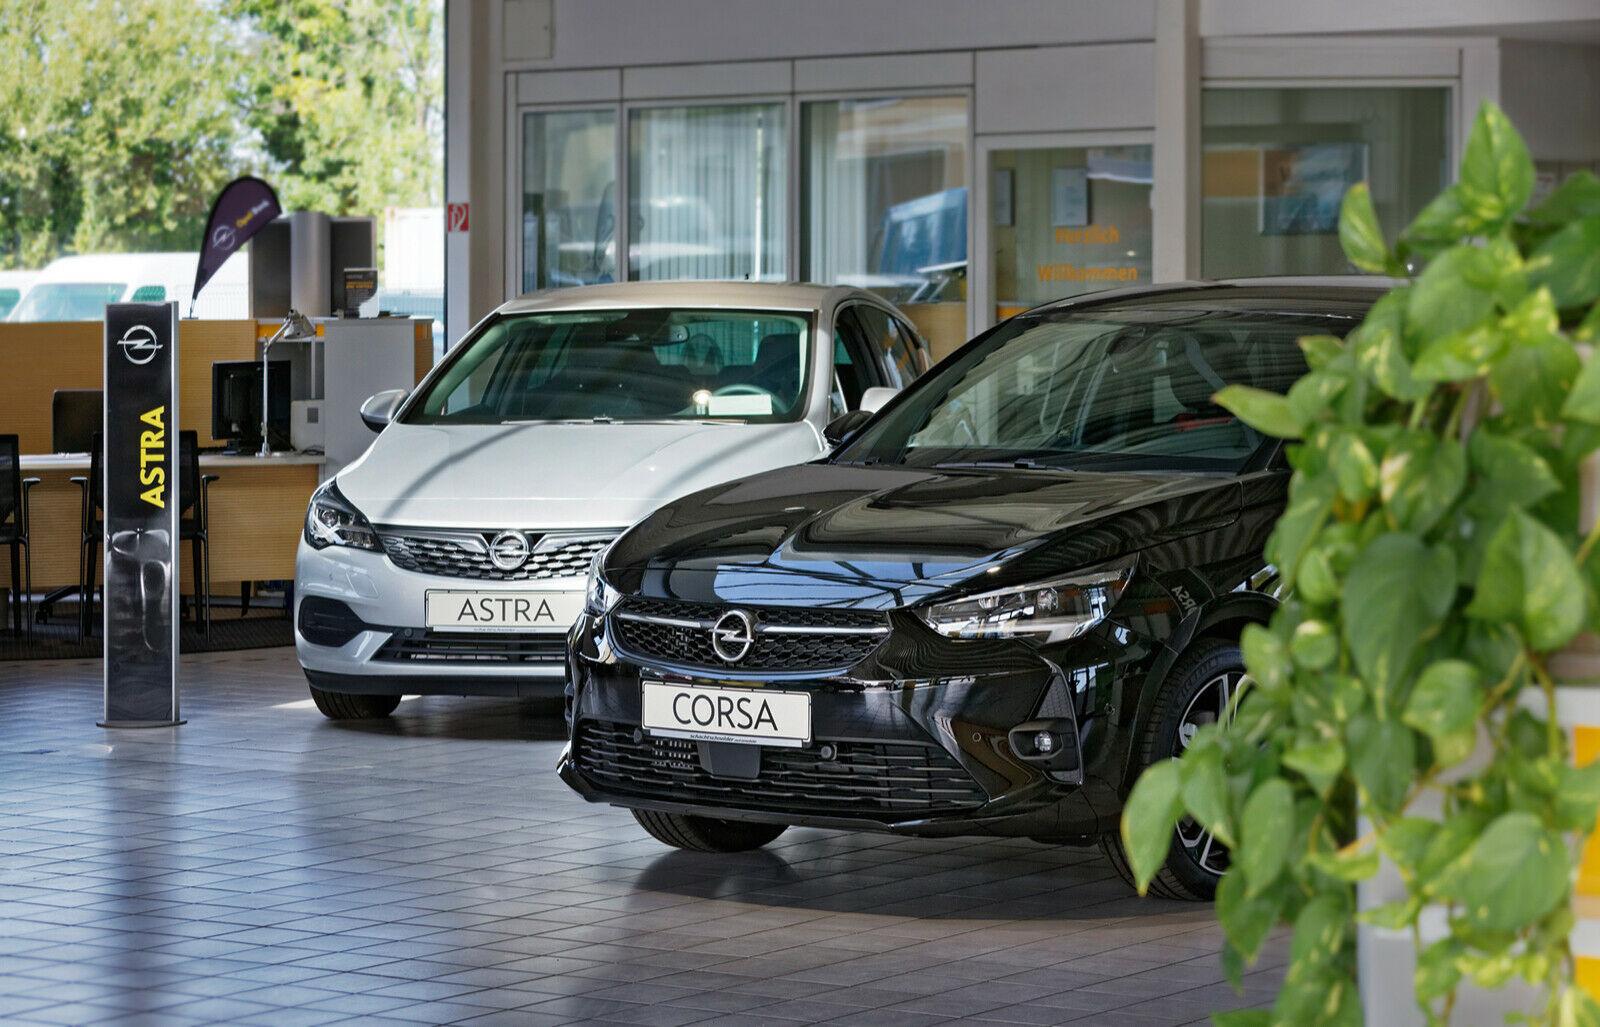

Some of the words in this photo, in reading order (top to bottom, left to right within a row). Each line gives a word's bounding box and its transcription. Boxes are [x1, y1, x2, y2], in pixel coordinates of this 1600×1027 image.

[140, 405, 165, 509] ASTRA
[457, 598, 555, 622] ASTRA
[672, 692, 779, 731] CORSA
